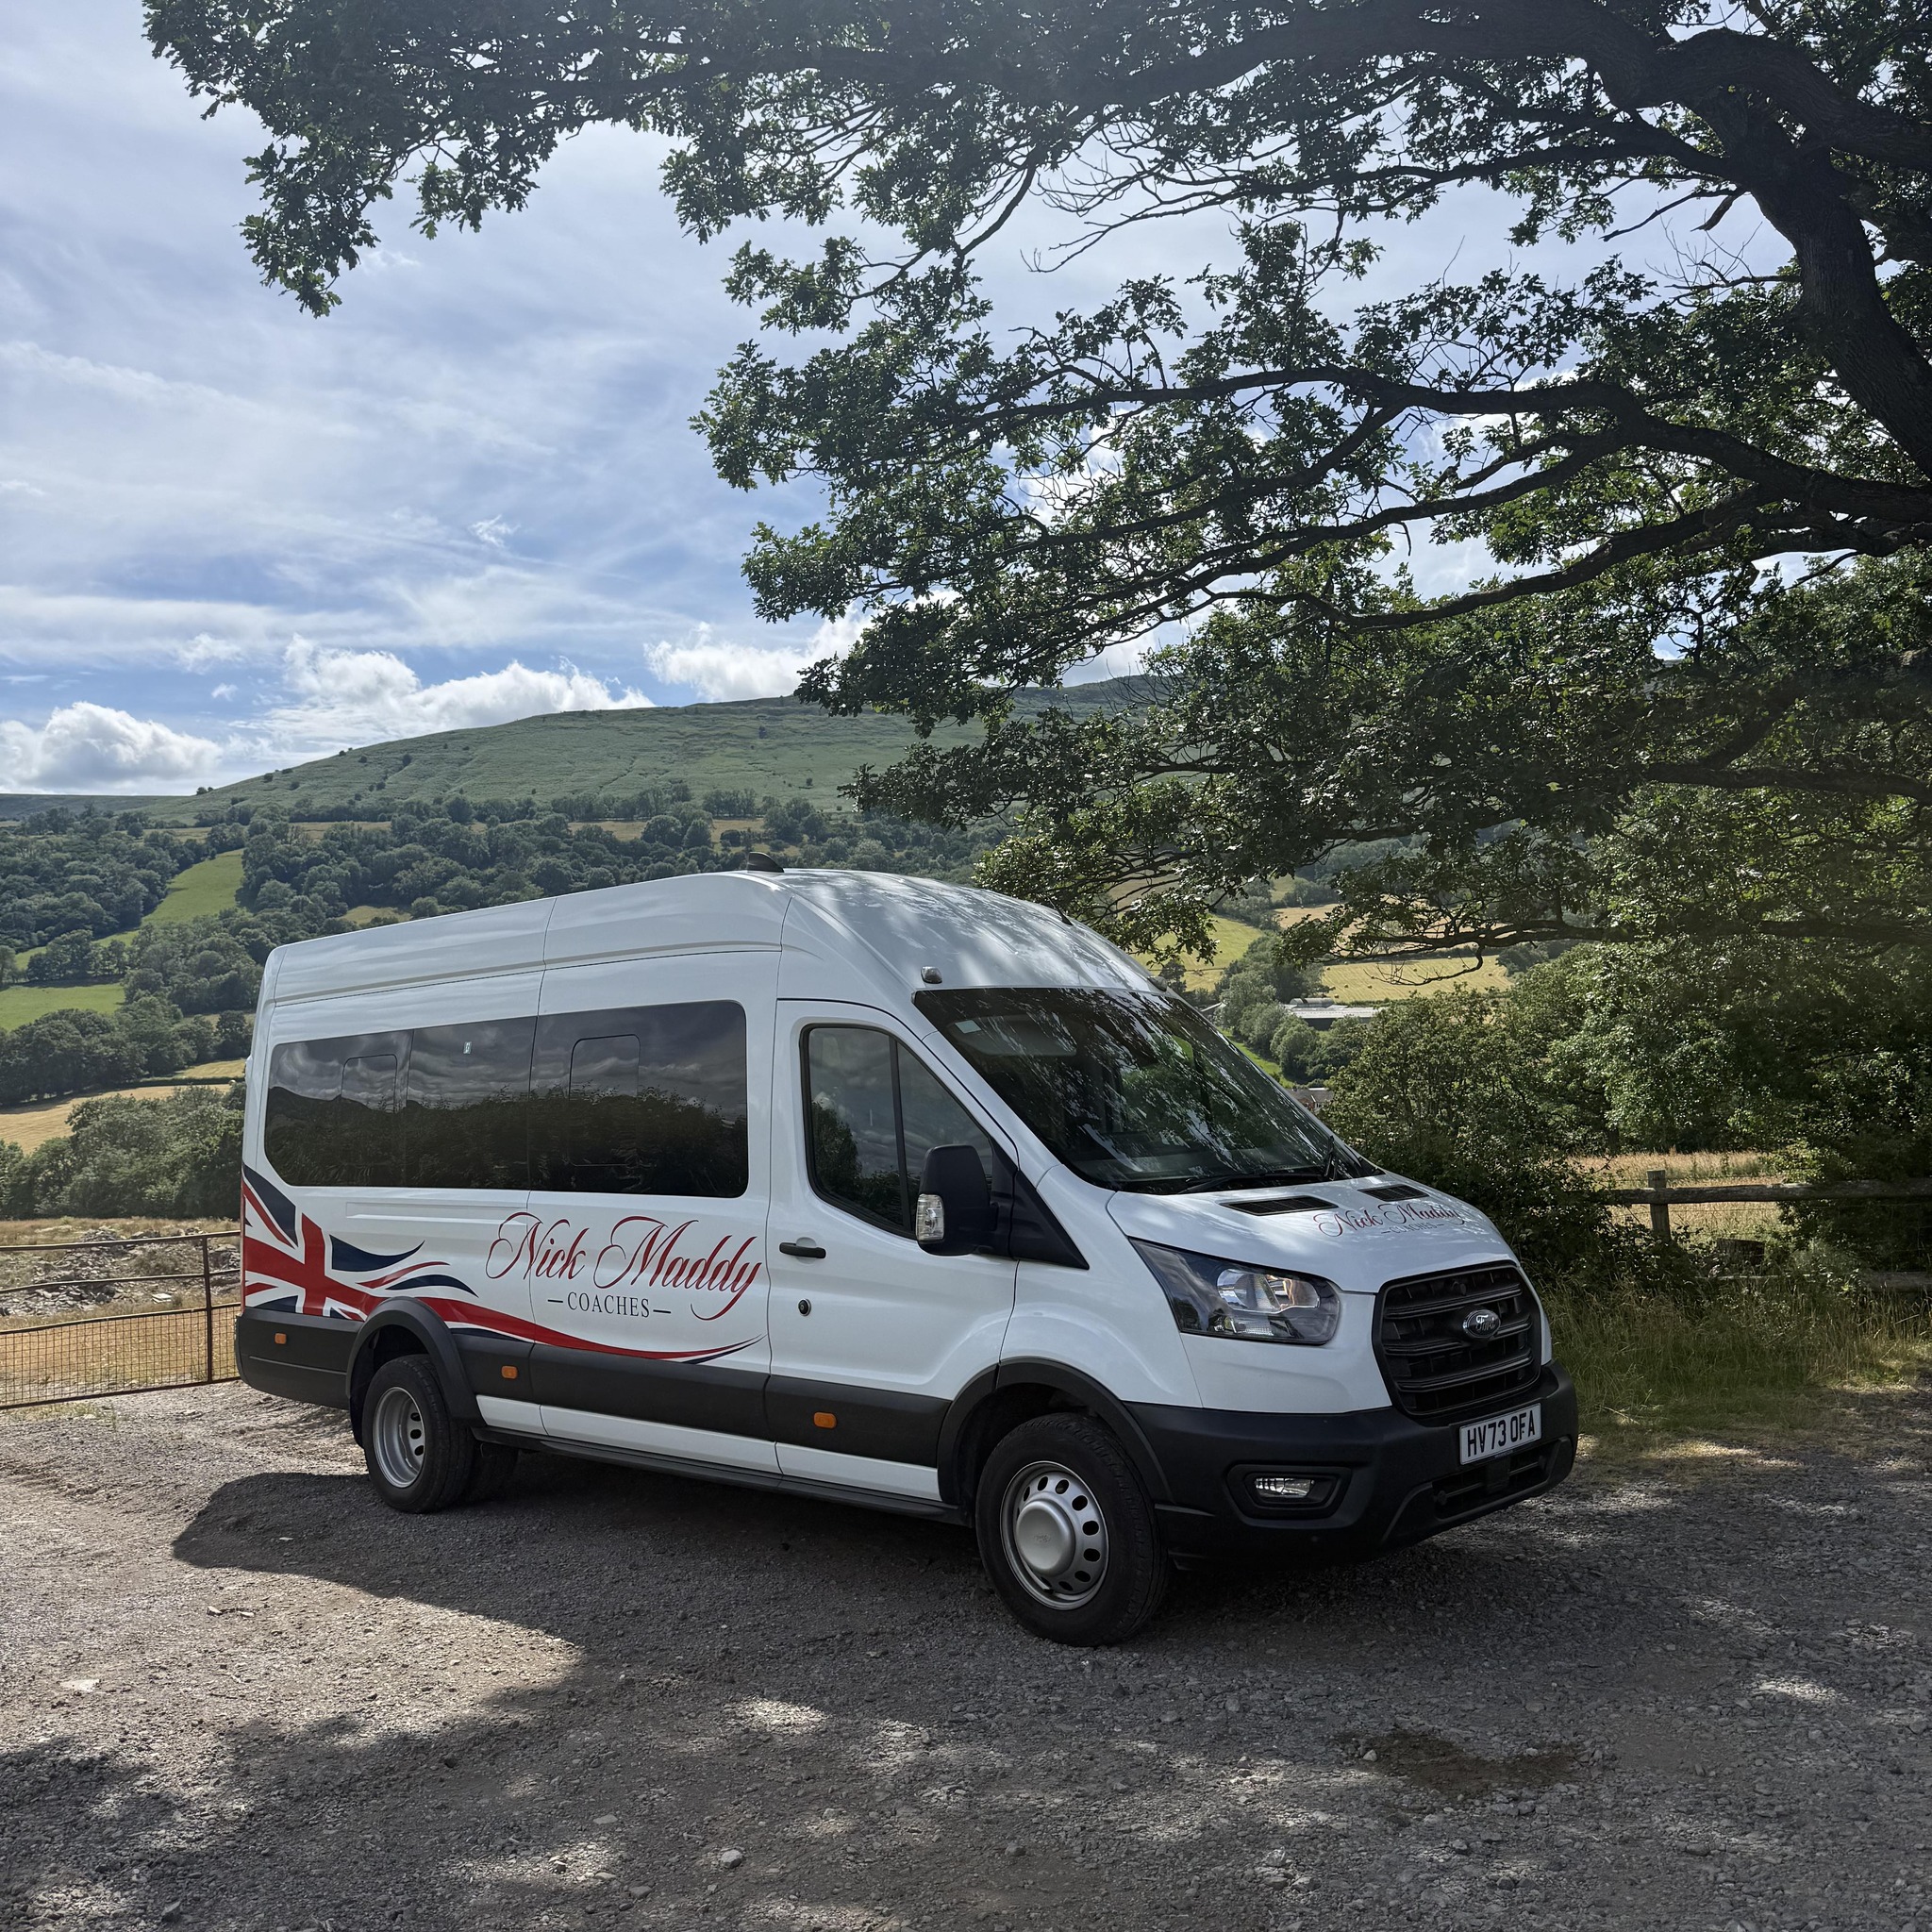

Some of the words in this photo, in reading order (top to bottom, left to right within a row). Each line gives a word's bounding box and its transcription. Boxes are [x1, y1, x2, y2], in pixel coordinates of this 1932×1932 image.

[1313, 1209, 1383, 1237] Nick
[486, 1212, 590, 1280] Nick
[594, 1215, 762, 1321] Maddy
[567, 1291, 650, 1317] COACHES
[1475, 1314, 1496, 1332] Ford
[1467, 1419, 1507, 1457] HV73
[1510, 1410, 1536, 1443] OFA
